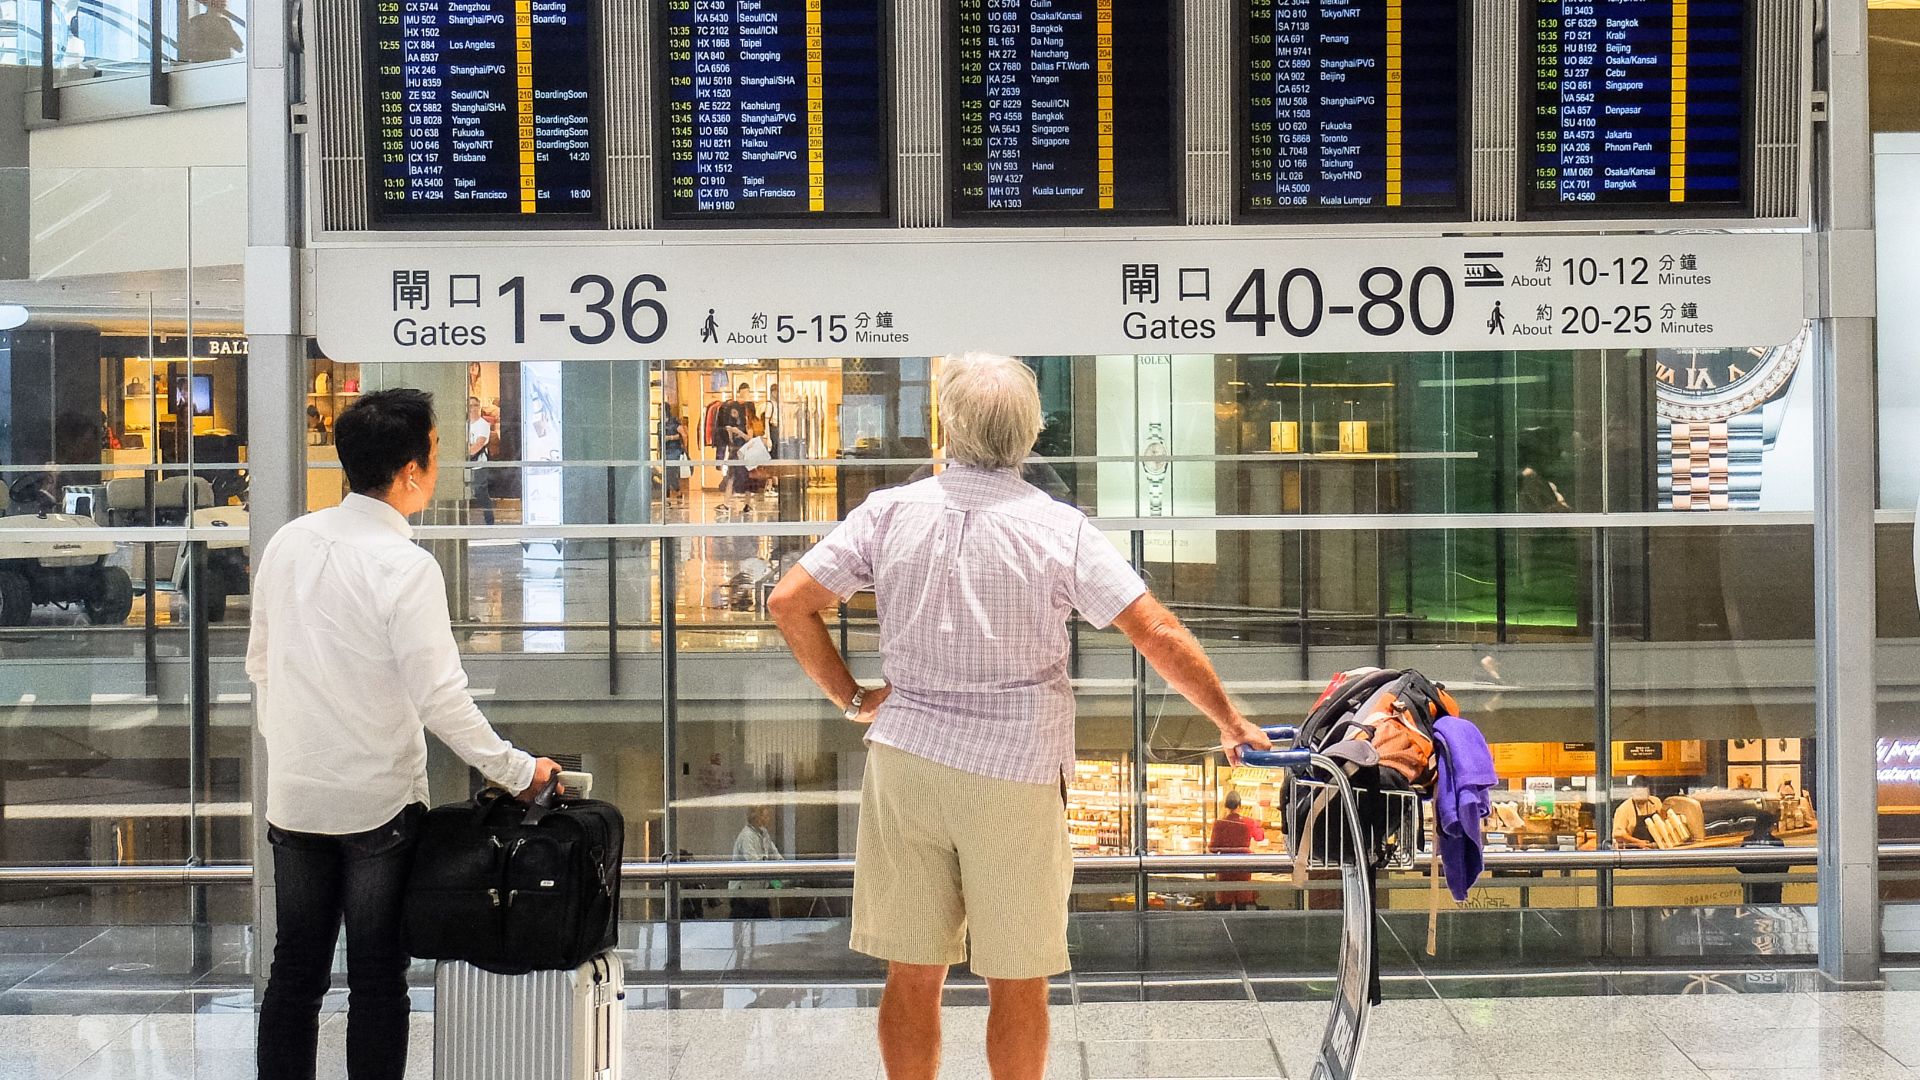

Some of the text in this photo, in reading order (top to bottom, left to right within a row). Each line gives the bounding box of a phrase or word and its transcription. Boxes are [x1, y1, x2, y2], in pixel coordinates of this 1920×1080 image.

[378, 1, 566, 13] 12:50 Zhengzhou Boarding
[668, 0, 760, 11] 13:30 Taipei
[739, 13, 777, 22] Seoul/ICN
[960, 11, 1082, 20] 14:10 Osaka/Kansai
[1320, 8, 1360, 19] Tokyo/NRT
[378, 14, 566, 25] 12:50 Shanghai/PVG Boarding
[1537, 18, 1638, 29] 15:30 Bangkok
[669, 25, 777, 35] 13:35 Seoul/ICN
[960, 24, 1063, 34] 14:10 Bangkok
[1320, 34, 1348, 44] Penang
[1537, 30, 1625, 40] 15:35 Krabi
[379, 40, 495, 50] 12:55 Los Angeles
[669, 38, 761, 49] 13:40 Taipei
[960, 36, 1063, 47] 14:15 Da Nang
[961, 49, 1068, 59] 14:15 Nanchang
[1537, 43, 1631, 54] 15:35 Beijing
[670, 50, 780, 61] 13:40 Chongqing
[1537, 55, 1657, 65] 15:35 Osaka/Kansai
[961, 61, 1090, 71] 14:20 Dallas FT.Worth
[1320, 58, 1374, 69] Shanghai/PVG
[380, 64, 505, 76] 13:00 Shanghai/PVG
[1537, 68, 1625, 77] 15:40 Cebu
[670, 75, 795, 86] 13:40 Shanghai/SHA
[961, 74, 1059, 84] 14:20 Yangon
[1320, 71, 1345, 82] Beijing
[1537, 80, 1643, 91] 15:40 Singapore
[381, 89, 587, 100] 13:00 Seoul/ICN BoardingSoon
[671, 101, 780, 111] 13:45 Kaohsiung
[962, 98, 1069, 108] 14:25 Seoul/ICN
[1320, 96, 1374, 107] Shanghai/PVG
[381, 102, 506, 113] 13:05 Shanghai/SHA
[1536, 105, 1641, 115] 15:45 Denpasar
[382, 114, 588, 126] 13:05 Yangon BoardingSoon
[671, 113, 796, 124] 13:45 Shanghai/PVG
[961, 111, 1064, 122] 14:25 Bangkok
[962, 124, 1069, 134] 14:25 Singapore
[1320, 121, 1352, 130] Fukuoka
[382, 127, 588, 138] 13:05 Fukuoka BoardingSoon
[672, 126, 782, 137] 13:45 Tokyo/NRT
[1536, 130, 1632, 139] 15:50 Jakarta
[672, 138, 768, 148] 13:50 Haikou
[1031, 136, 1069, 147] Singapore
[1320, 133, 1348, 142] Toronto
[382, 139, 588, 151] 13:05 Tokyo/NRT BoardingSoon
[1320, 145, 1360, 156] Tokyo/NRT
[1536, 142, 1652, 152] 15:50 Phnom Penh
[383, 152, 590, 162] 13:10 Brisbane Est 14:20
[672, 150, 796, 161] 13:55 Shanghai/PVG
[1032, 162, 1054, 170] Hanoi
[1320, 158, 1353, 169] Taichung
[1320, 170, 1362, 181] Tokyo/HND
[1536, 167, 1655, 176] 15:50 Osaka/Kansai
[384, 177, 475, 188] 13:10 Taipei
[742, 176, 764, 186] Taipei
[1536, 179, 1636, 190] 15:55 Bangkok
[384, 189, 590, 199] 13:10 San Francisco Est 18:00
[742, 188, 795, 197] San Francisco
[1032, 186, 1084, 196] Kuala Lumpur
[1320, 195, 1371, 205] Kuala Lumpur
[1535, 255, 1551, 272] 約
[1658, 253, 1697, 271] 分鐘
[1562, 257, 1649, 286] 10-12
[1122, 264, 1210, 305] 閘口
[1511, 275, 1551, 287] About
[1658, 274, 1711, 286] Minutes
[393, 270, 480, 311] 閘口
[1225, 266, 1454, 337] 40-80
[498, 274, 668, 344] 1-36
[1536, 304, 1552, 321] 約
[1659, 302, 1698, 320] 分鐘
[751, 312, 768, 330] 約
[854, 311, 894, 329] 分鐘
[1123, 312, 1216, 339] Gates
[1561, 306, 1651, 334] 20-25
[393, 318, 487, 346] Gates
[776, 314, 848, 343] 5-15
[1512, 323, 1552, 335] About
[1660, 321, 1713, 334] Minutes
[726, 332, 767, 344] About
[855, 331, 909, 343] Minutes
